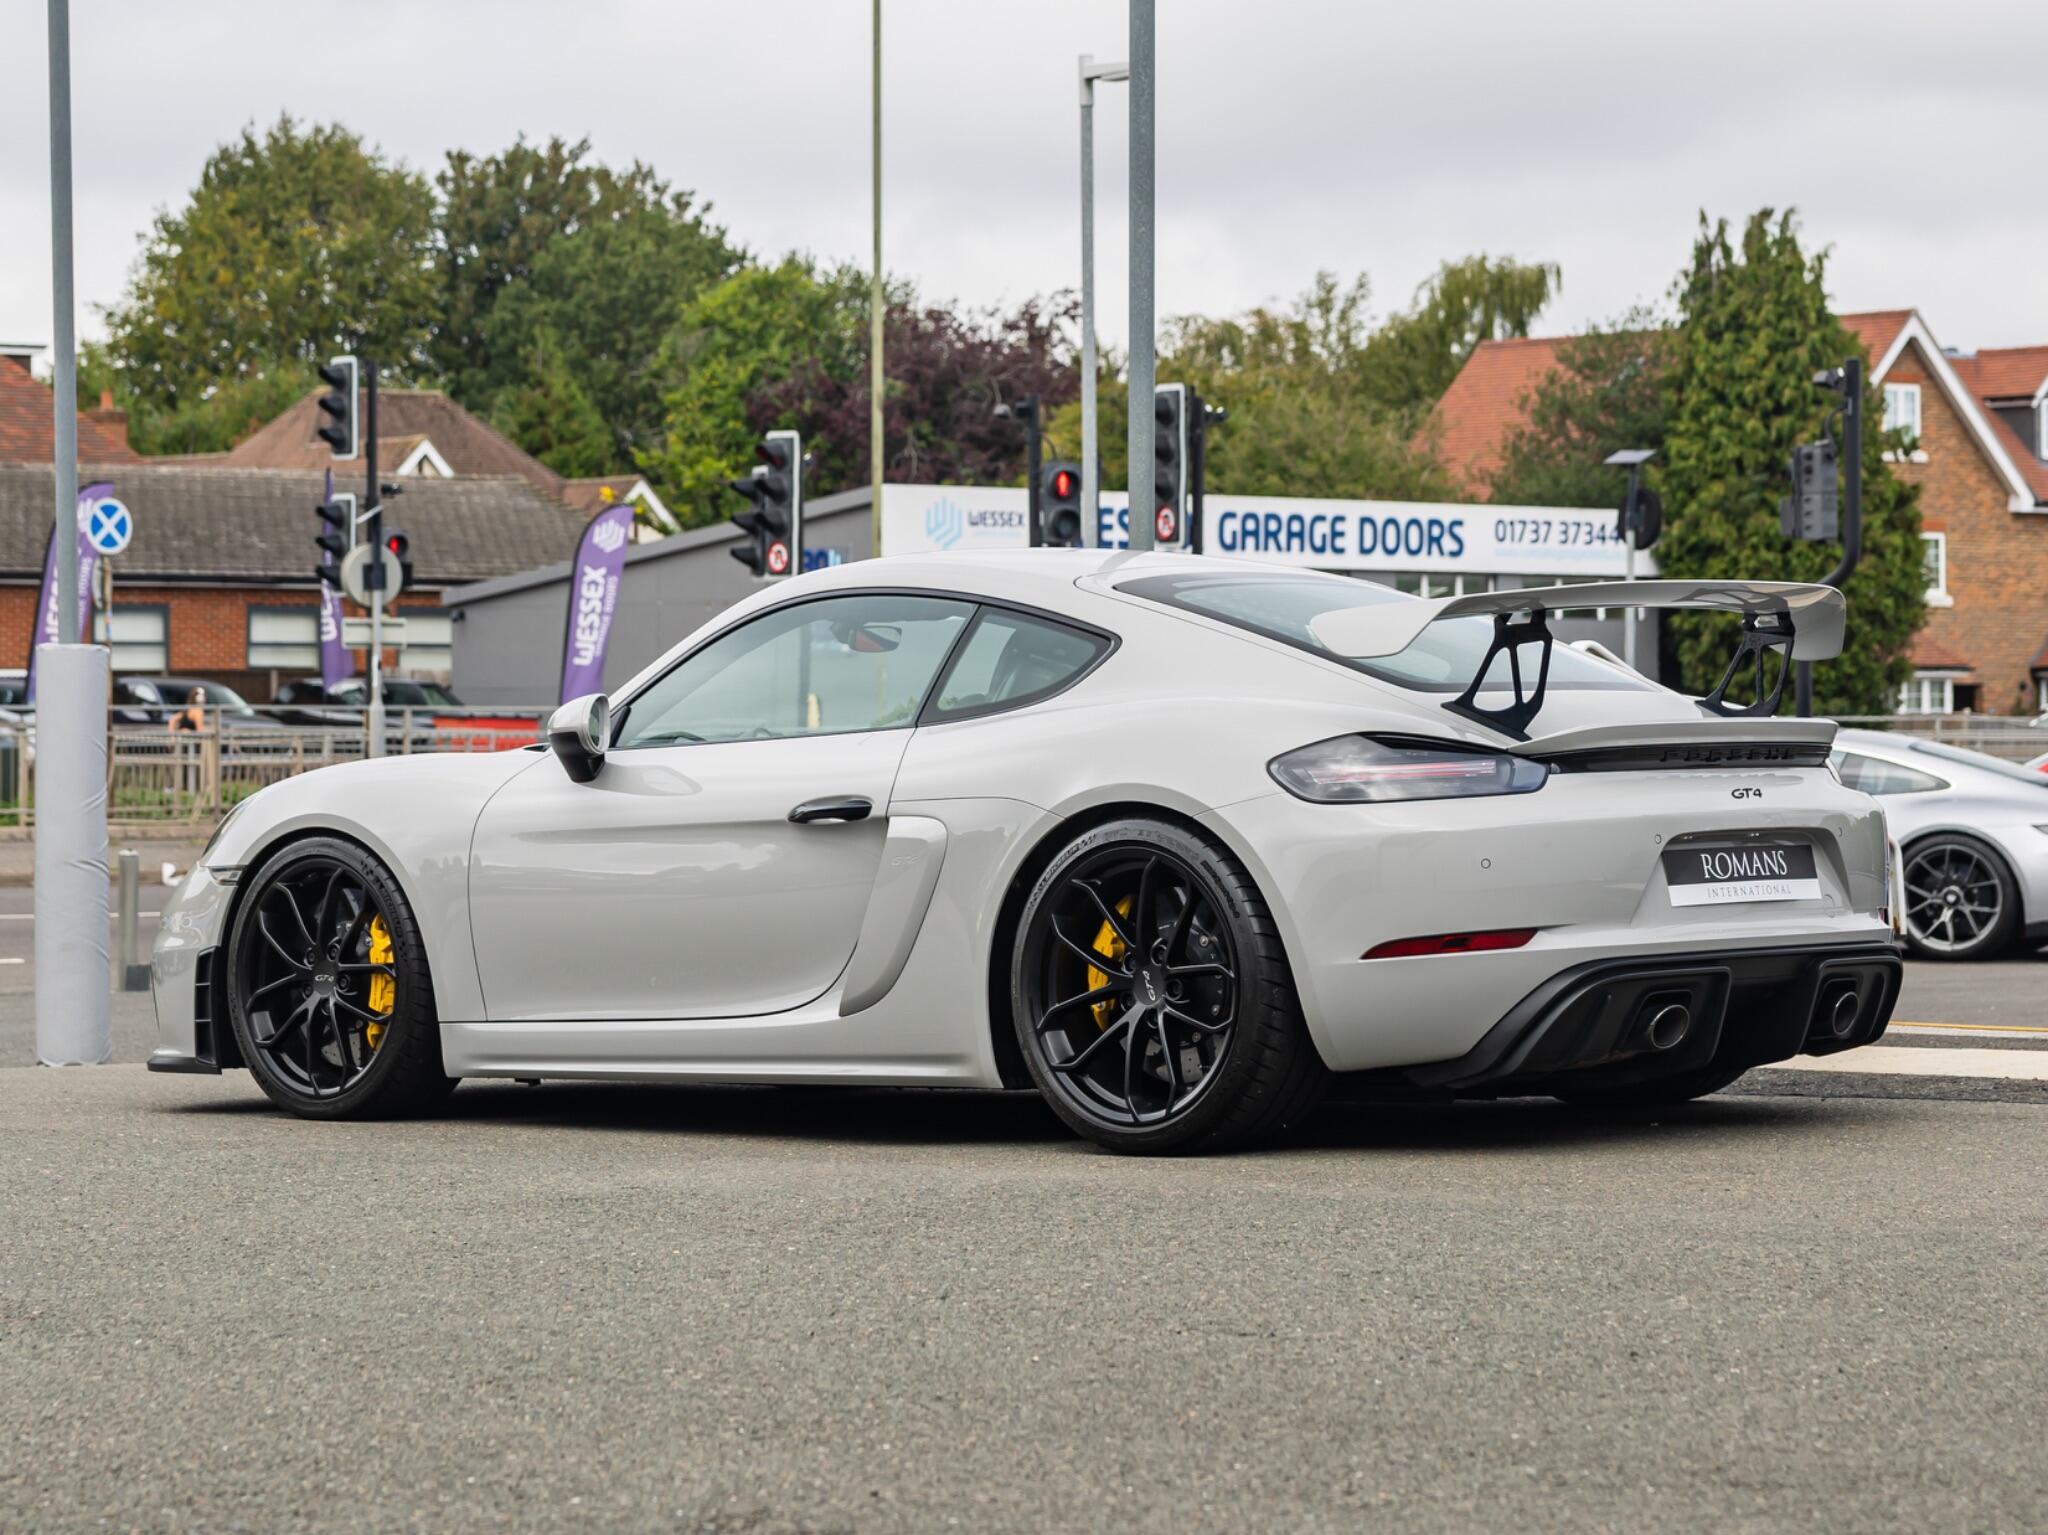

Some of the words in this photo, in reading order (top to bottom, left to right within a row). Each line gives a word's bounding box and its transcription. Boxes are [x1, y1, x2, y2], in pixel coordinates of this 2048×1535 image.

[967, 509, 1024, 528] WESSEX
[1218, 511, 1347, 554] GARAGE
[1358, 515, 1465, 558] DOORS
[1494, 519, 1552, 544] 01737
[572, 565, 608, 667] WESSEX
[1730, 787, 1763, 799] GT4
[1700, 850, 1788, 880] ROMANS
[1707, 884, 1792, 899] INTERNATIONAL
